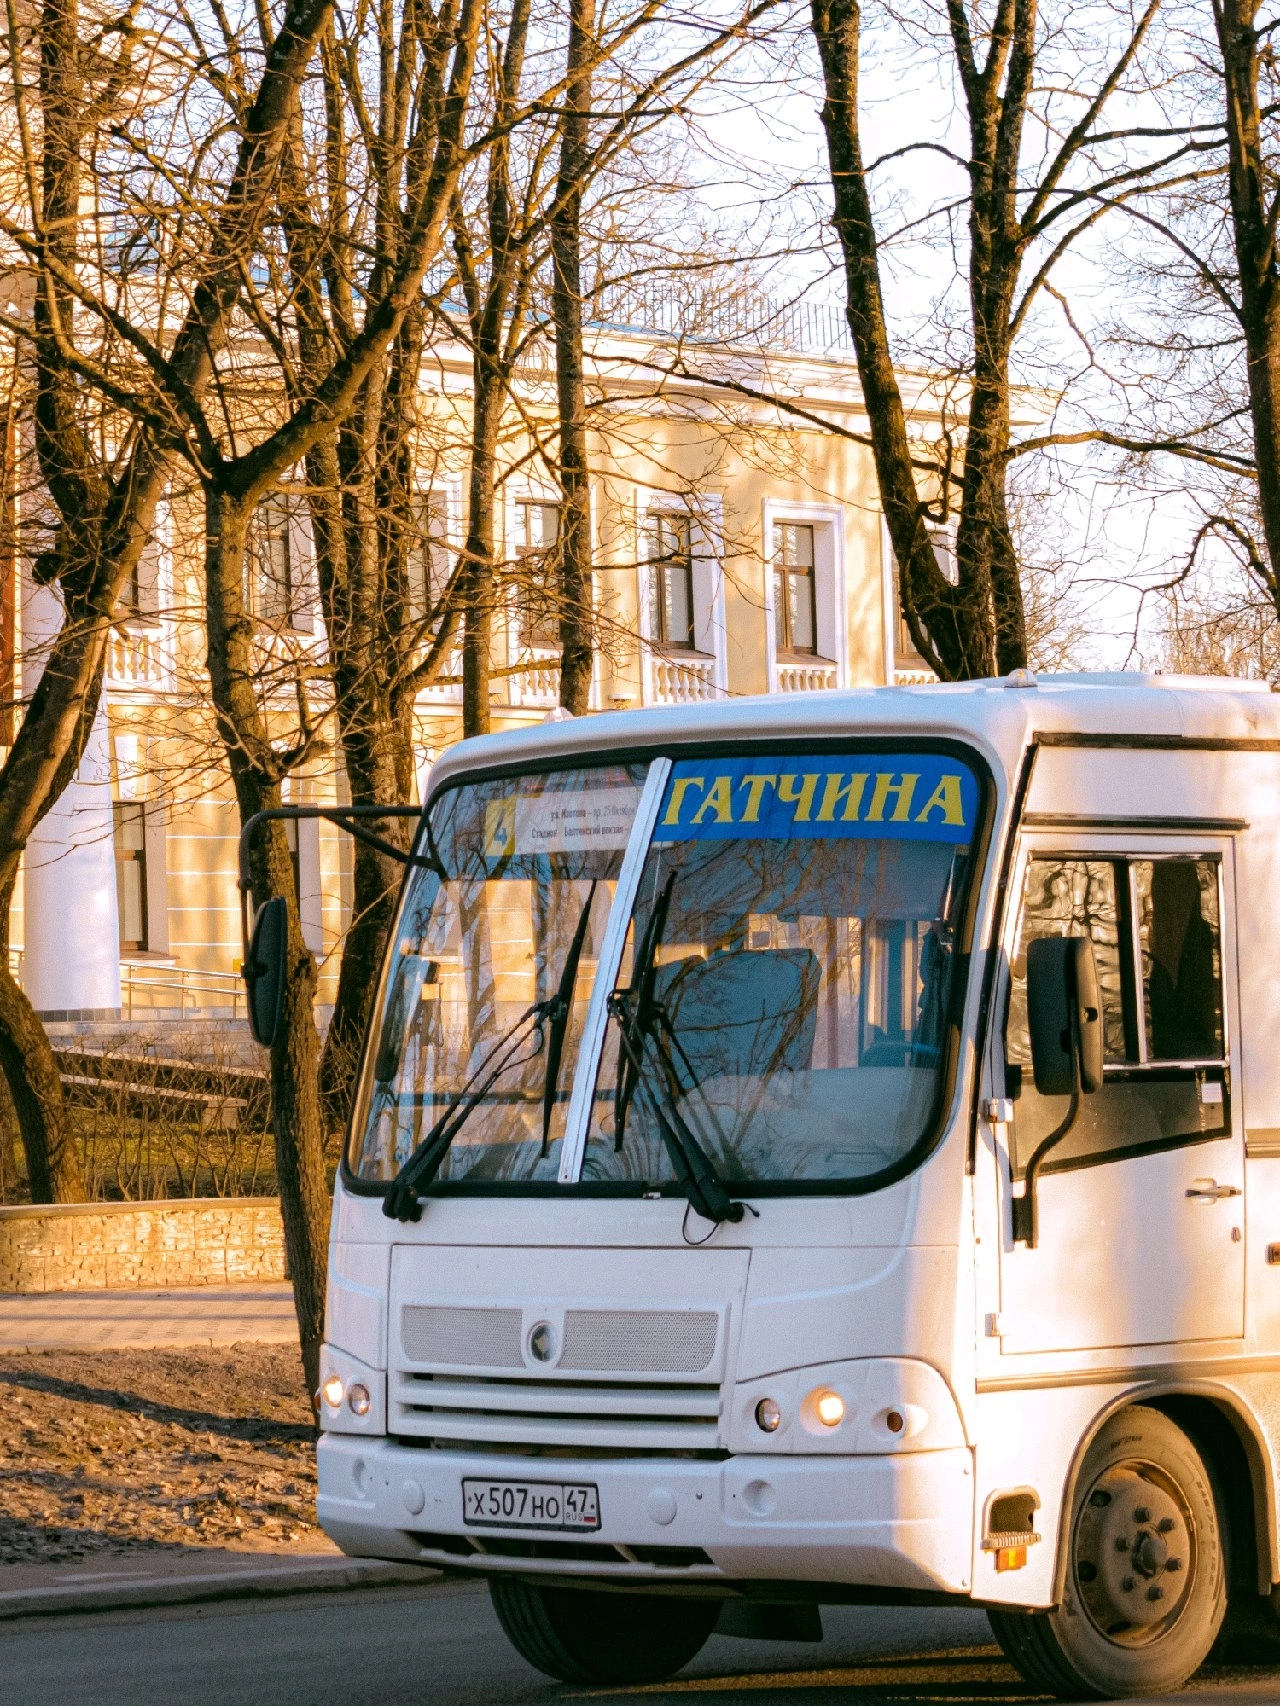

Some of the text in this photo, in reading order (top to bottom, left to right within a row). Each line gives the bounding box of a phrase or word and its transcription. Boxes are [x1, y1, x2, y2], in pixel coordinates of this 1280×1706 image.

[660, 772, 966, 826] ГАТЧИНА
[494, 808, 508, 846] 4
[565, 1512, 583, 1521] RUS
[566, 1489, 588, 1513] 47
